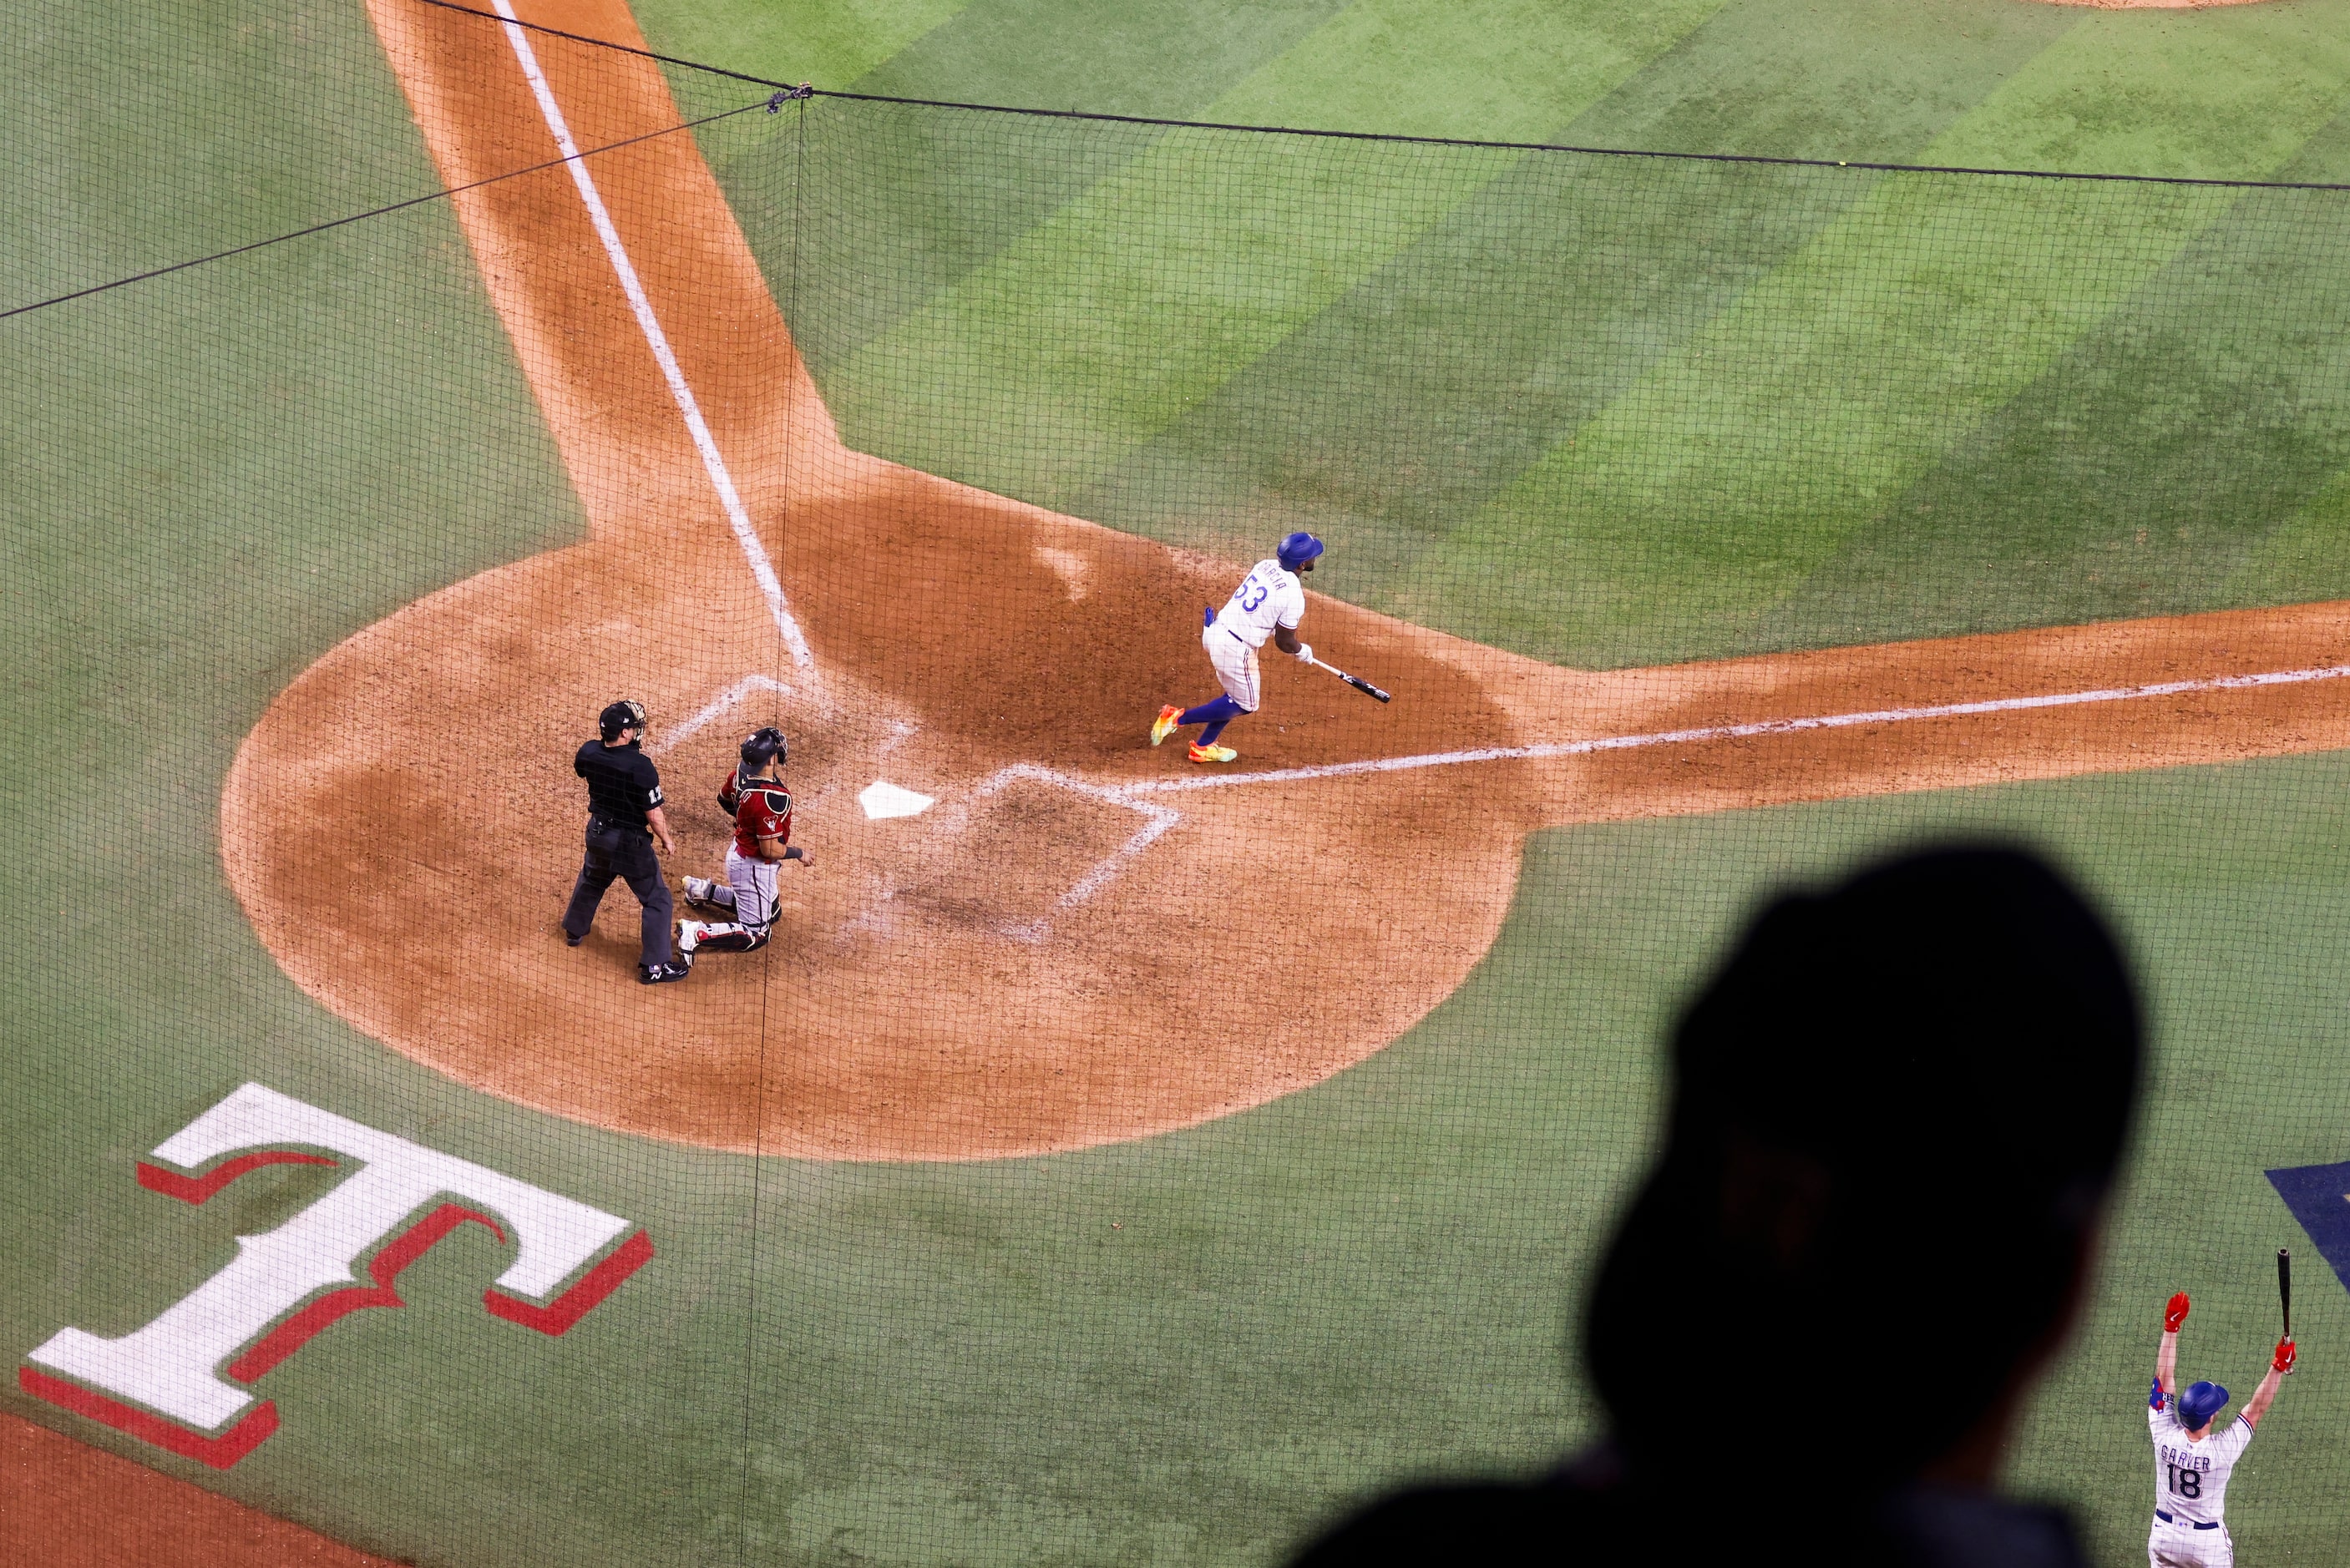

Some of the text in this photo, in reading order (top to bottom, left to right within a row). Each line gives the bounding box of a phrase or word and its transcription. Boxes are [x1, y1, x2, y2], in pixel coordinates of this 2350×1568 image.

[1234, 574, 1268, 613] 53
[1258, 562, 1287, 589] GARCIA
[20, 1082, 654, 1469] T
[2161, 1444, 2211, 1470] GARVER
[2167, 1464, 2202, 1500] 18
